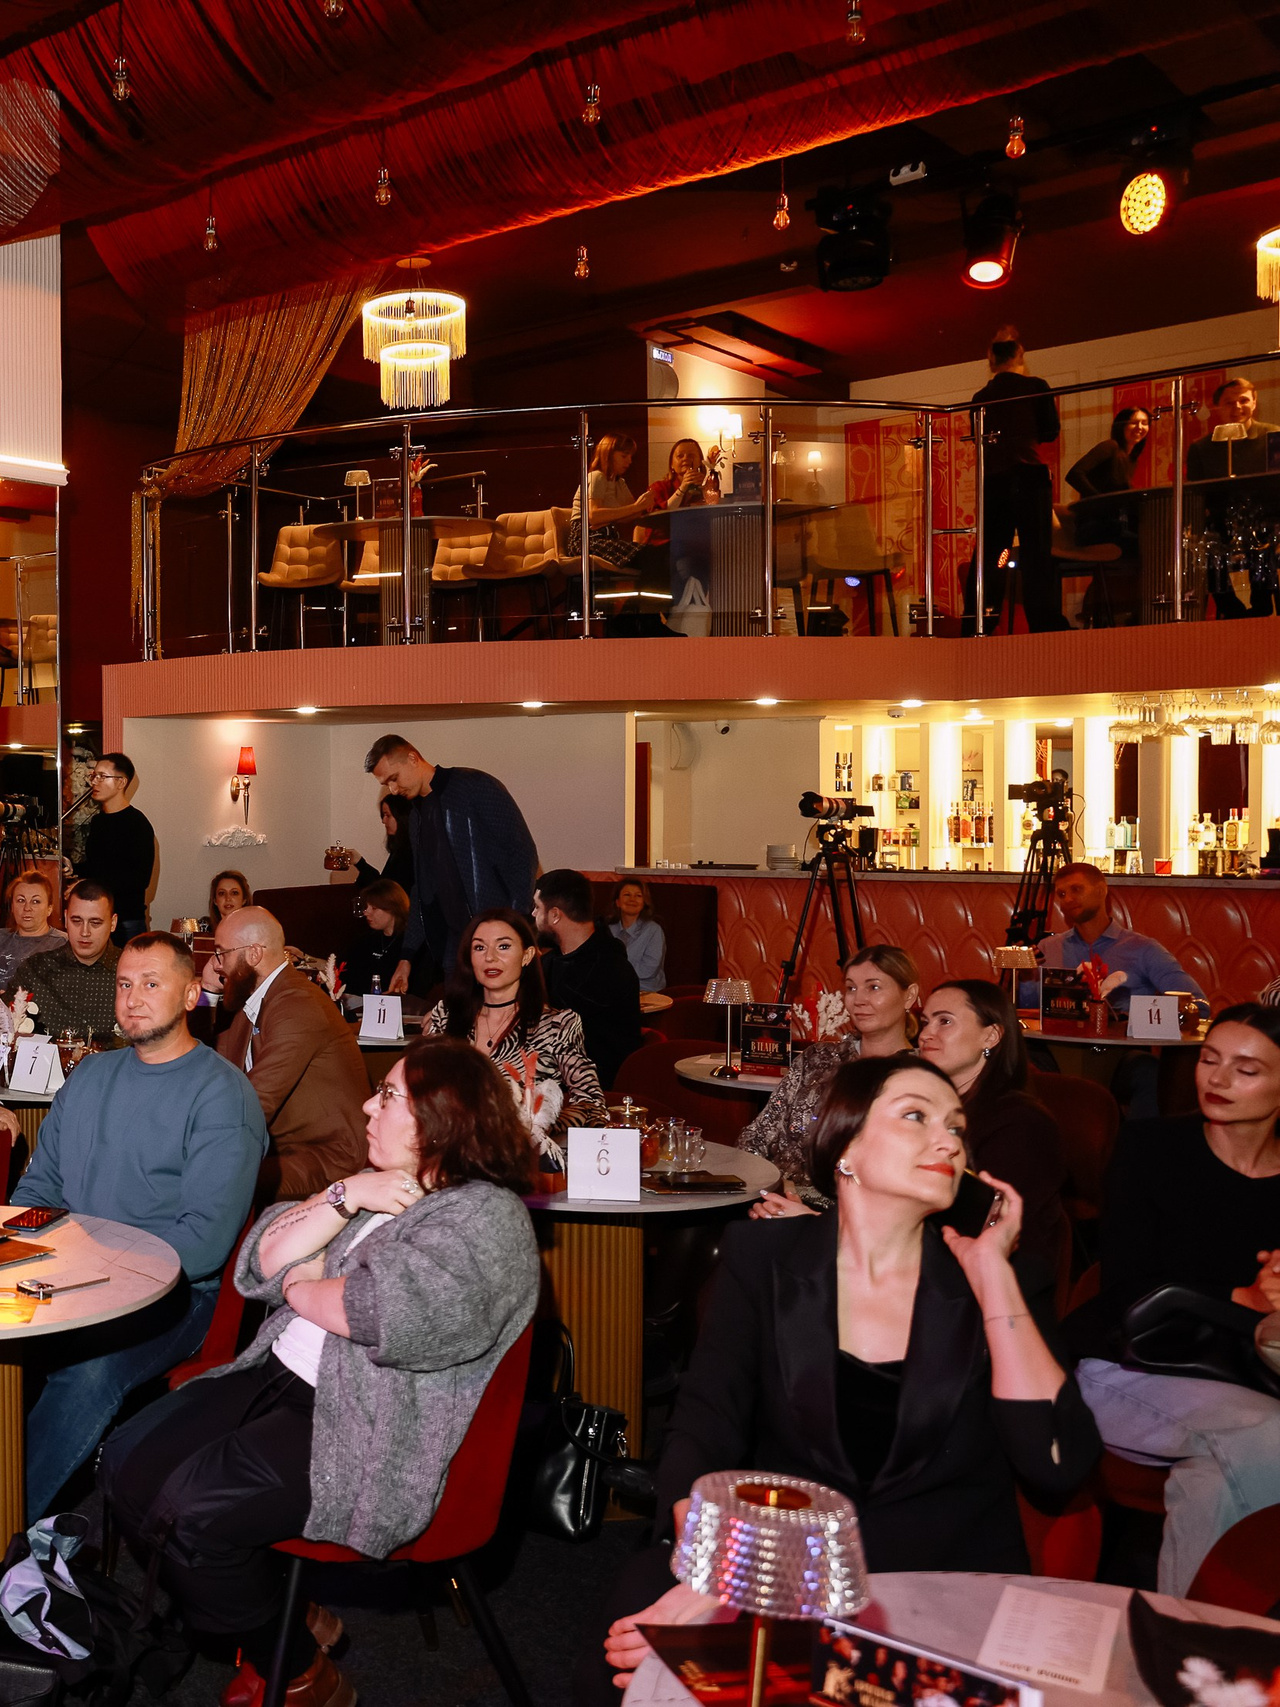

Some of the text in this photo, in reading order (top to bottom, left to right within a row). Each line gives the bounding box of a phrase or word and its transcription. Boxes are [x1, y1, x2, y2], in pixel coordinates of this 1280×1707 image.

[377, 1008, 386, 1024] 11
[1147, 1008, 1161, 1025] 14
[29, 1056, 37, 1075] 7
[596, 1148, 610, 1176] 6
